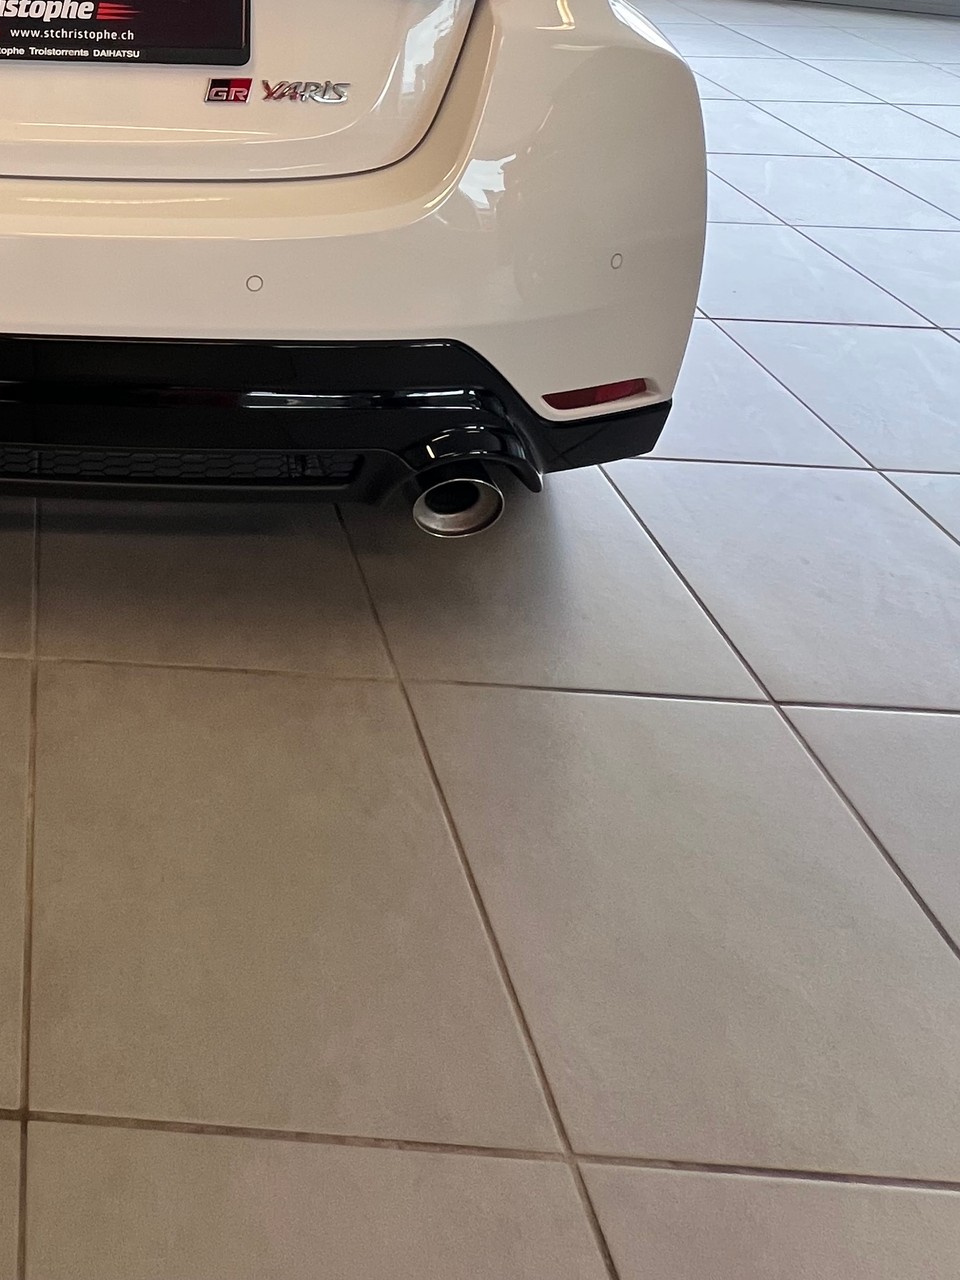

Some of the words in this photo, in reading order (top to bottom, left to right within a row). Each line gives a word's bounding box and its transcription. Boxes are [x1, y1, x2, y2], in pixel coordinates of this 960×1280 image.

[10, 28, 134, 42] www.stchristophe.ch
[29, 46, 89, 57] Troistorrents
[93, 48, 140, 58] DAIHATSU
[208, 87, 248, 101] GR
[261, 80, 351, 104] YARIS
